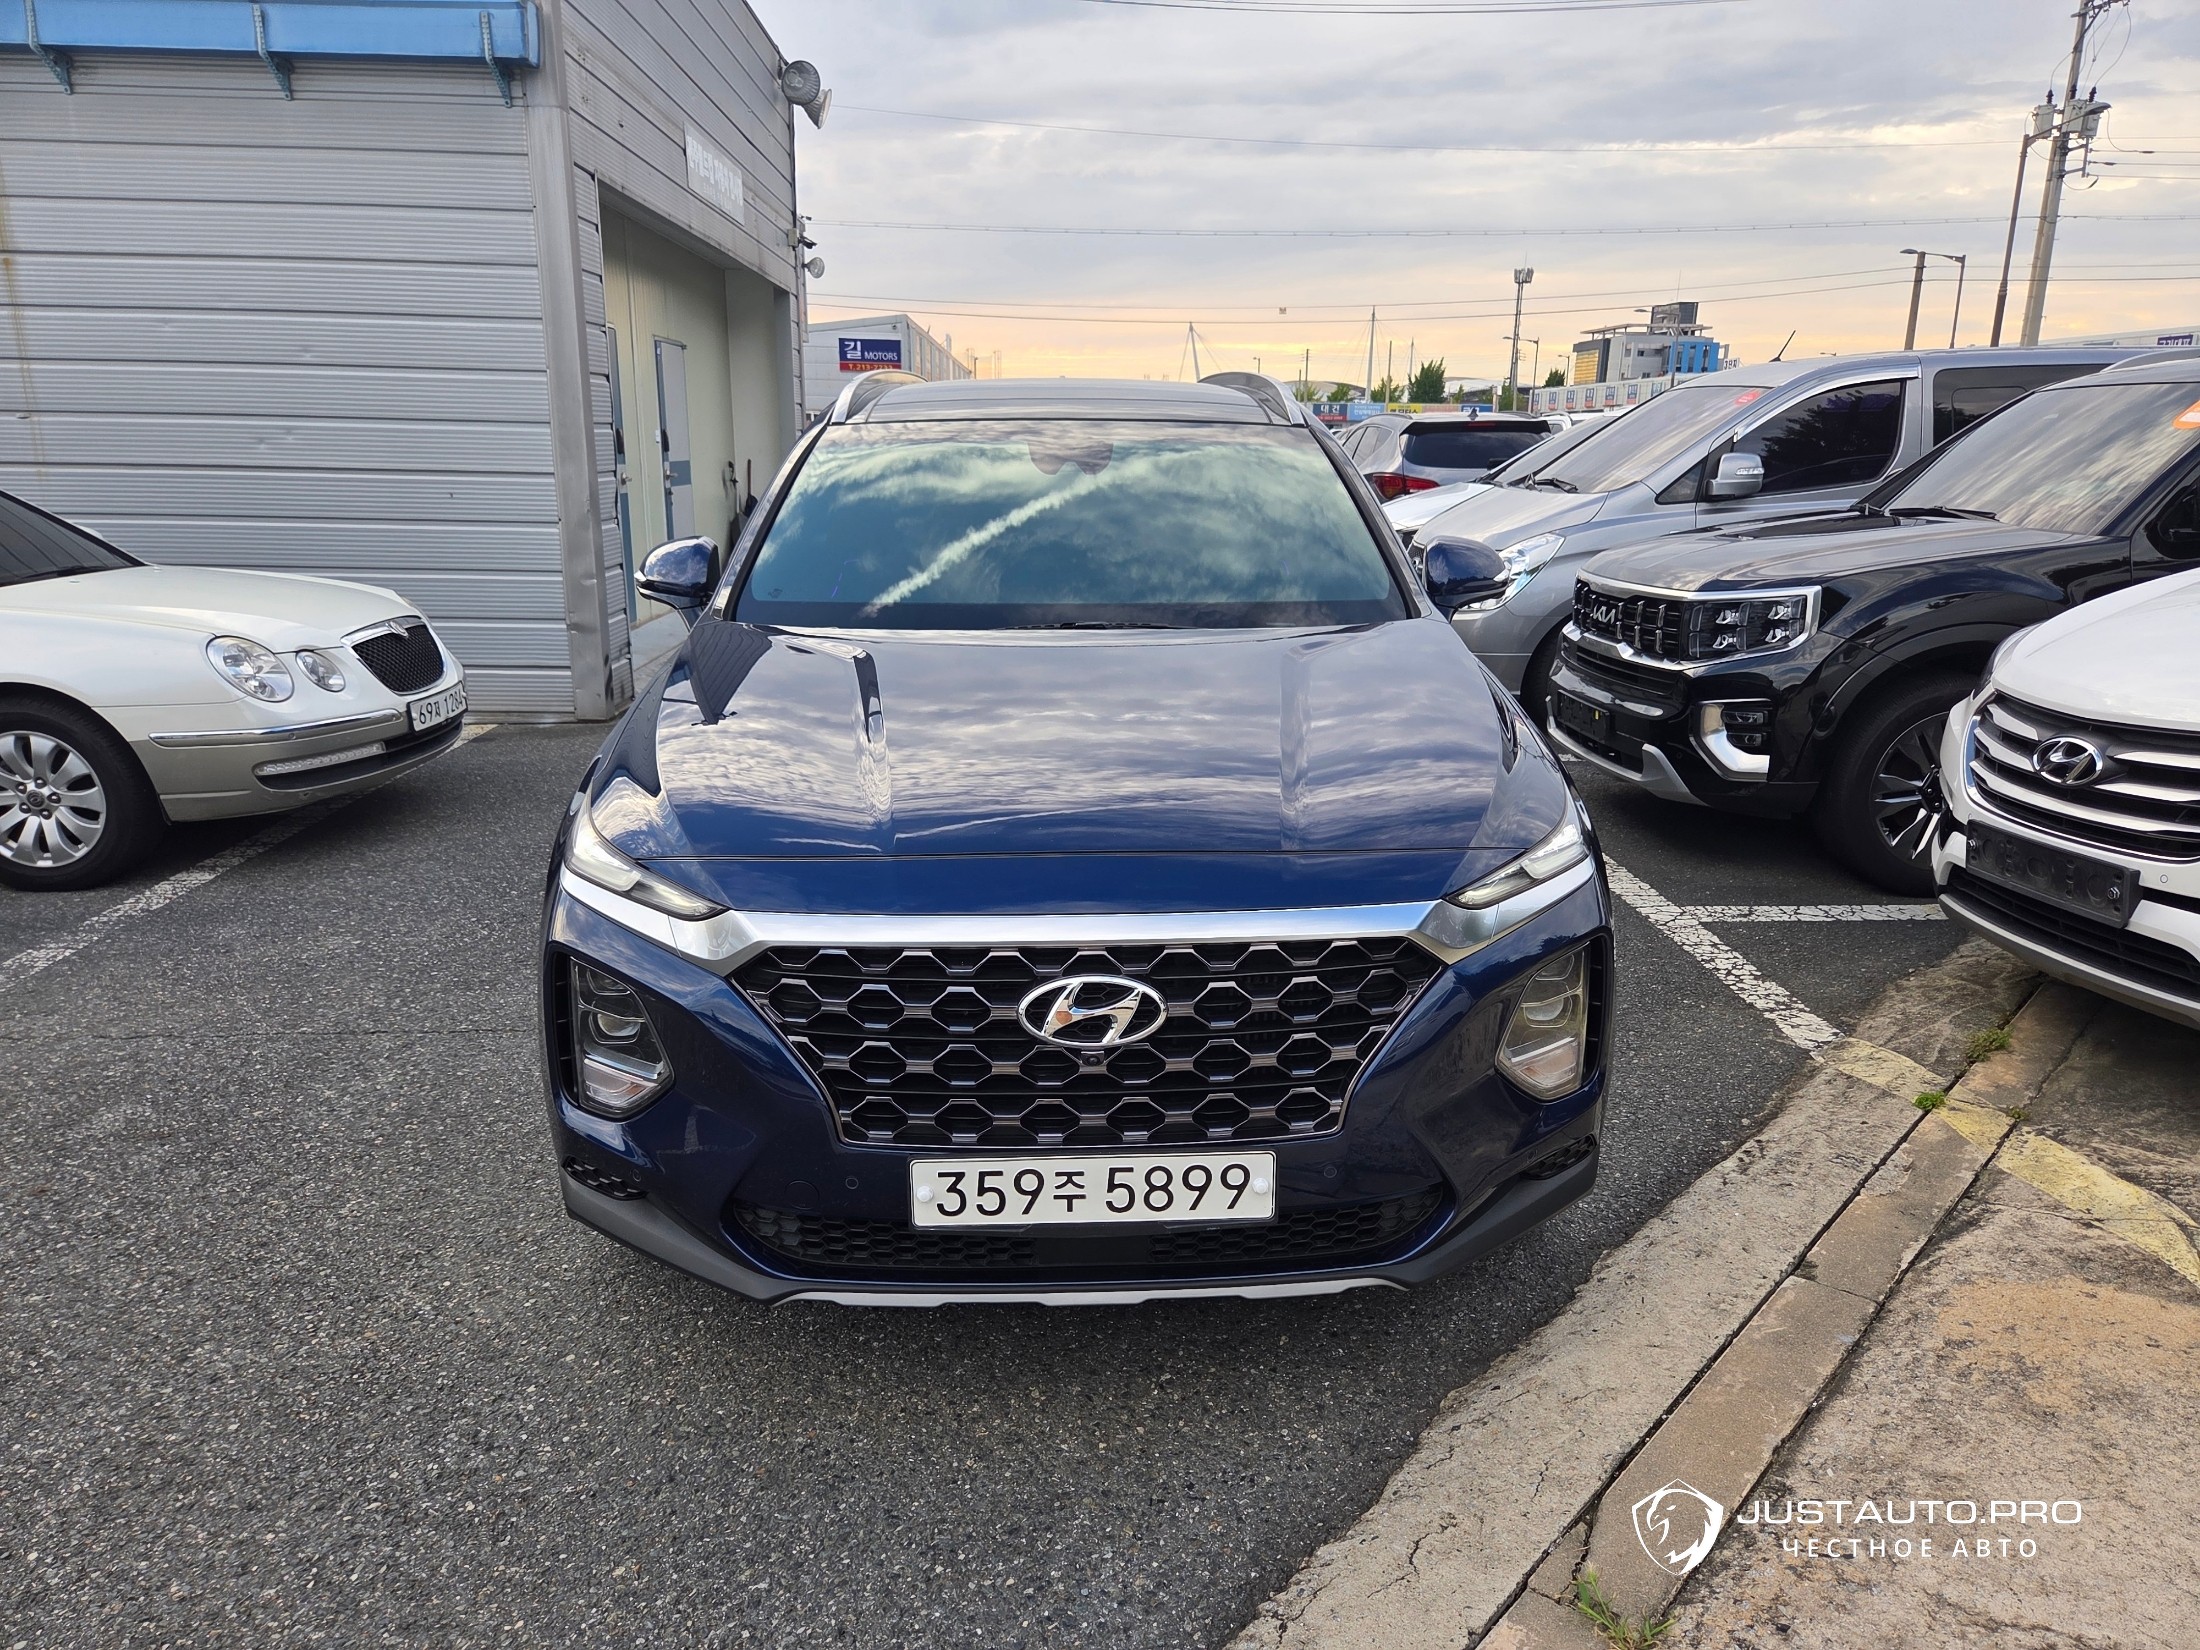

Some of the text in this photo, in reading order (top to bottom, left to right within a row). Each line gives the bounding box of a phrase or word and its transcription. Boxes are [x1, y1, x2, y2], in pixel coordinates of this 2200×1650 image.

[844, 340, 898, 361] 길 MOTORS
[936, 1163, 1252, 1217] 359주 5899
